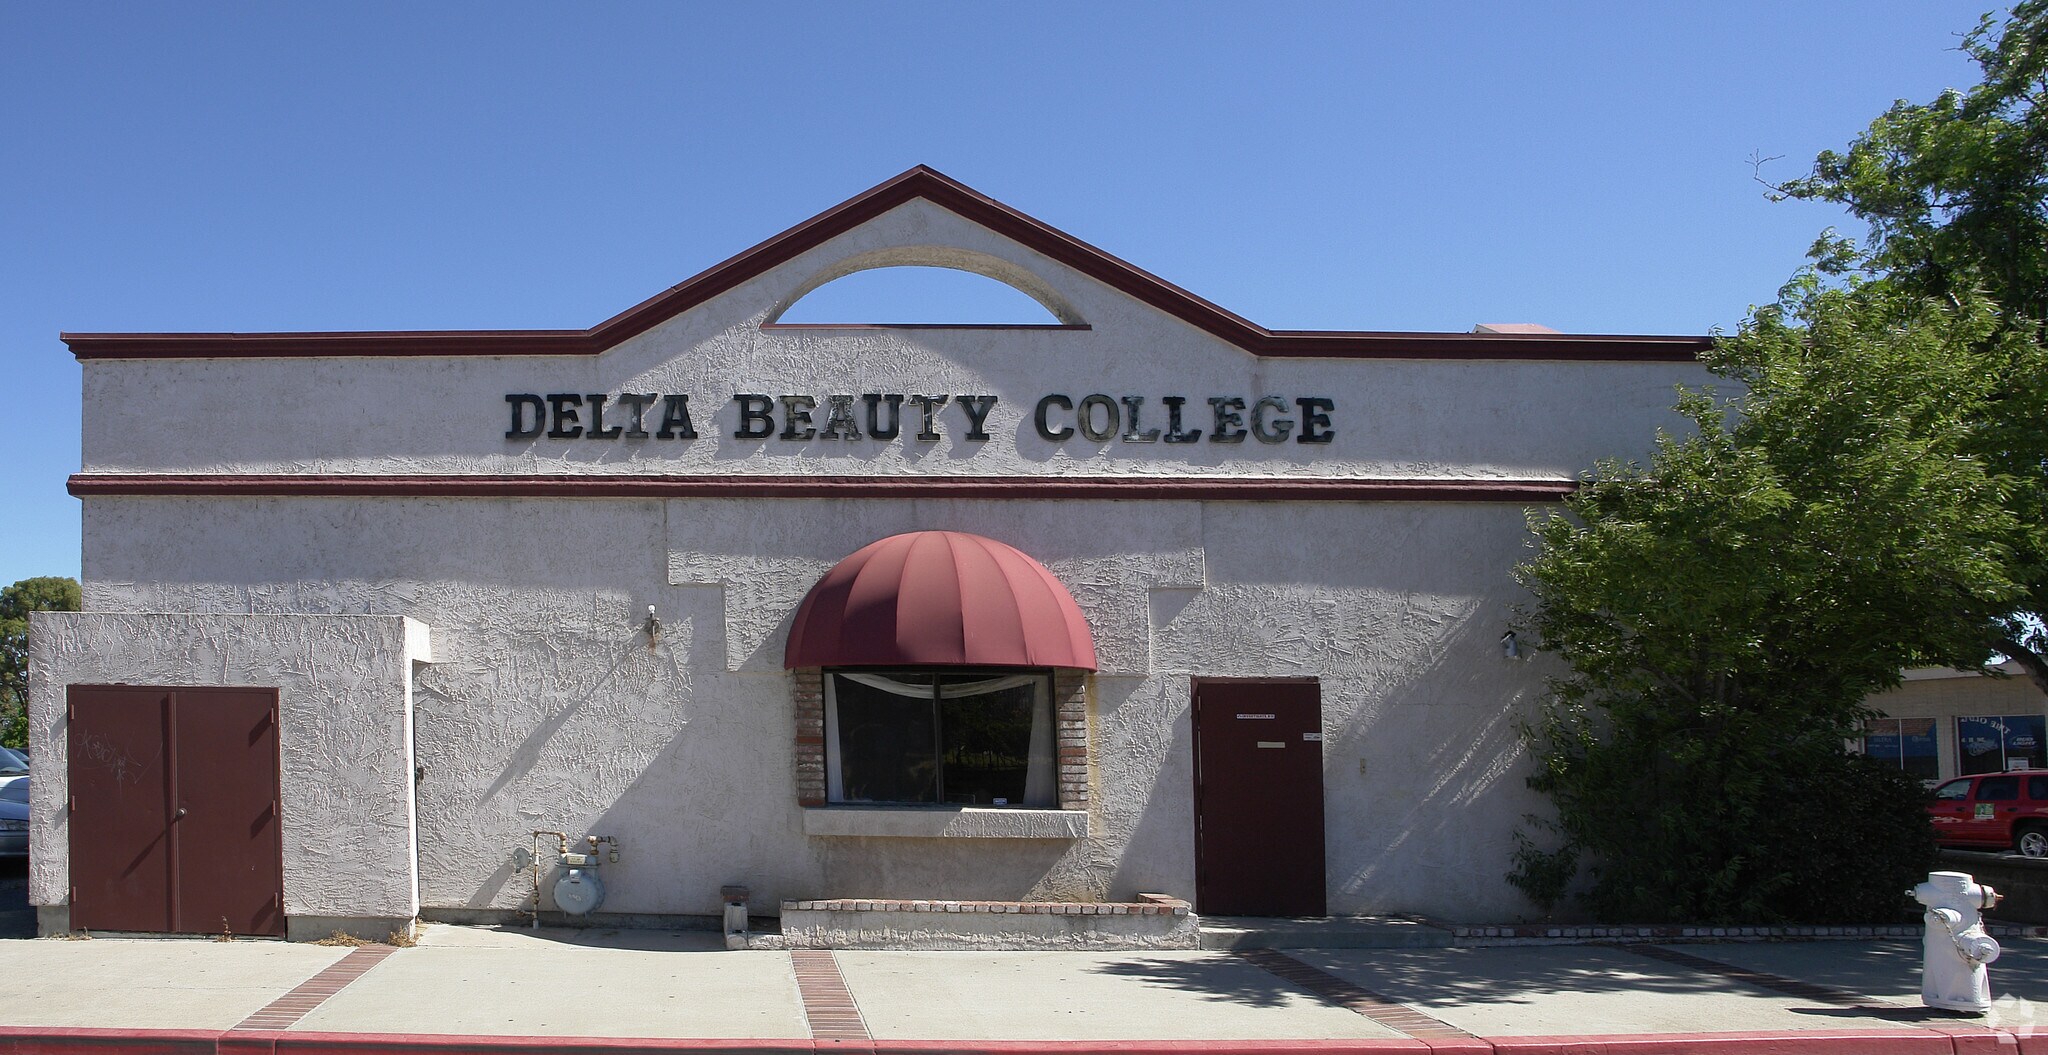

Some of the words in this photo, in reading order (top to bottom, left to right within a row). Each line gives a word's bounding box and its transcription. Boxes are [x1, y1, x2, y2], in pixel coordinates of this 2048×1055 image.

[505, 393, 698, 440] DELTA
[733, 393, 998, 441] BEAUTY
[1034, 393, 1335, 444] COLLEGE
